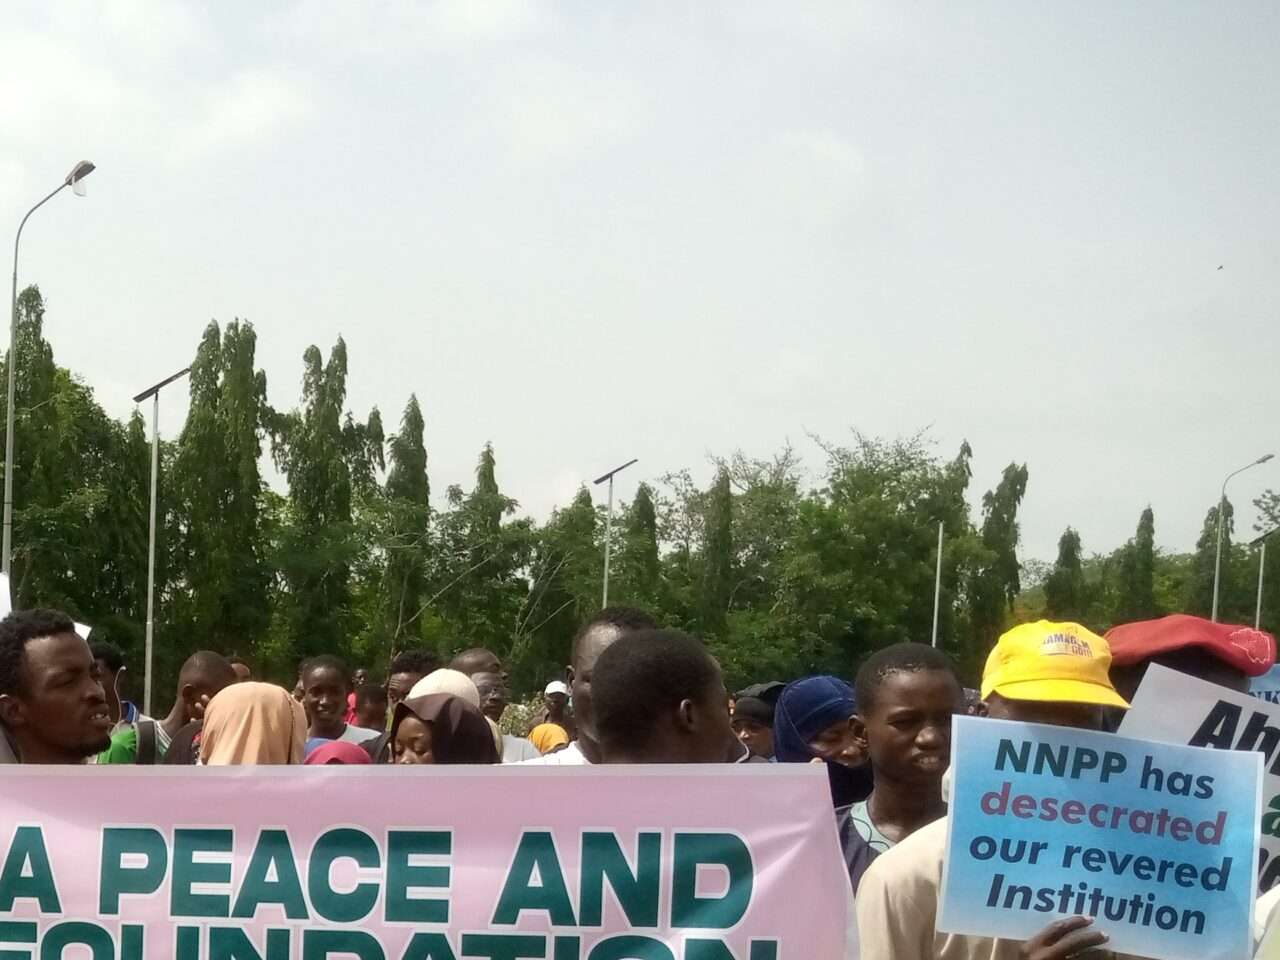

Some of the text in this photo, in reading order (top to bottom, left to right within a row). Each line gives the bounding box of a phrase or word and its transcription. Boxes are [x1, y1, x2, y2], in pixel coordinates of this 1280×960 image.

[994, 738, 1214, 800] NNPP has
[980, 782, 1228, 846] desecrated
[100, 828, 451, 922] PEACE
[492, 832, 753, 928] AND
[969, 836, 1048, 864] our
[1062, 846, 1233, 892] revered
[985, 873, 1206, 935] Institution
